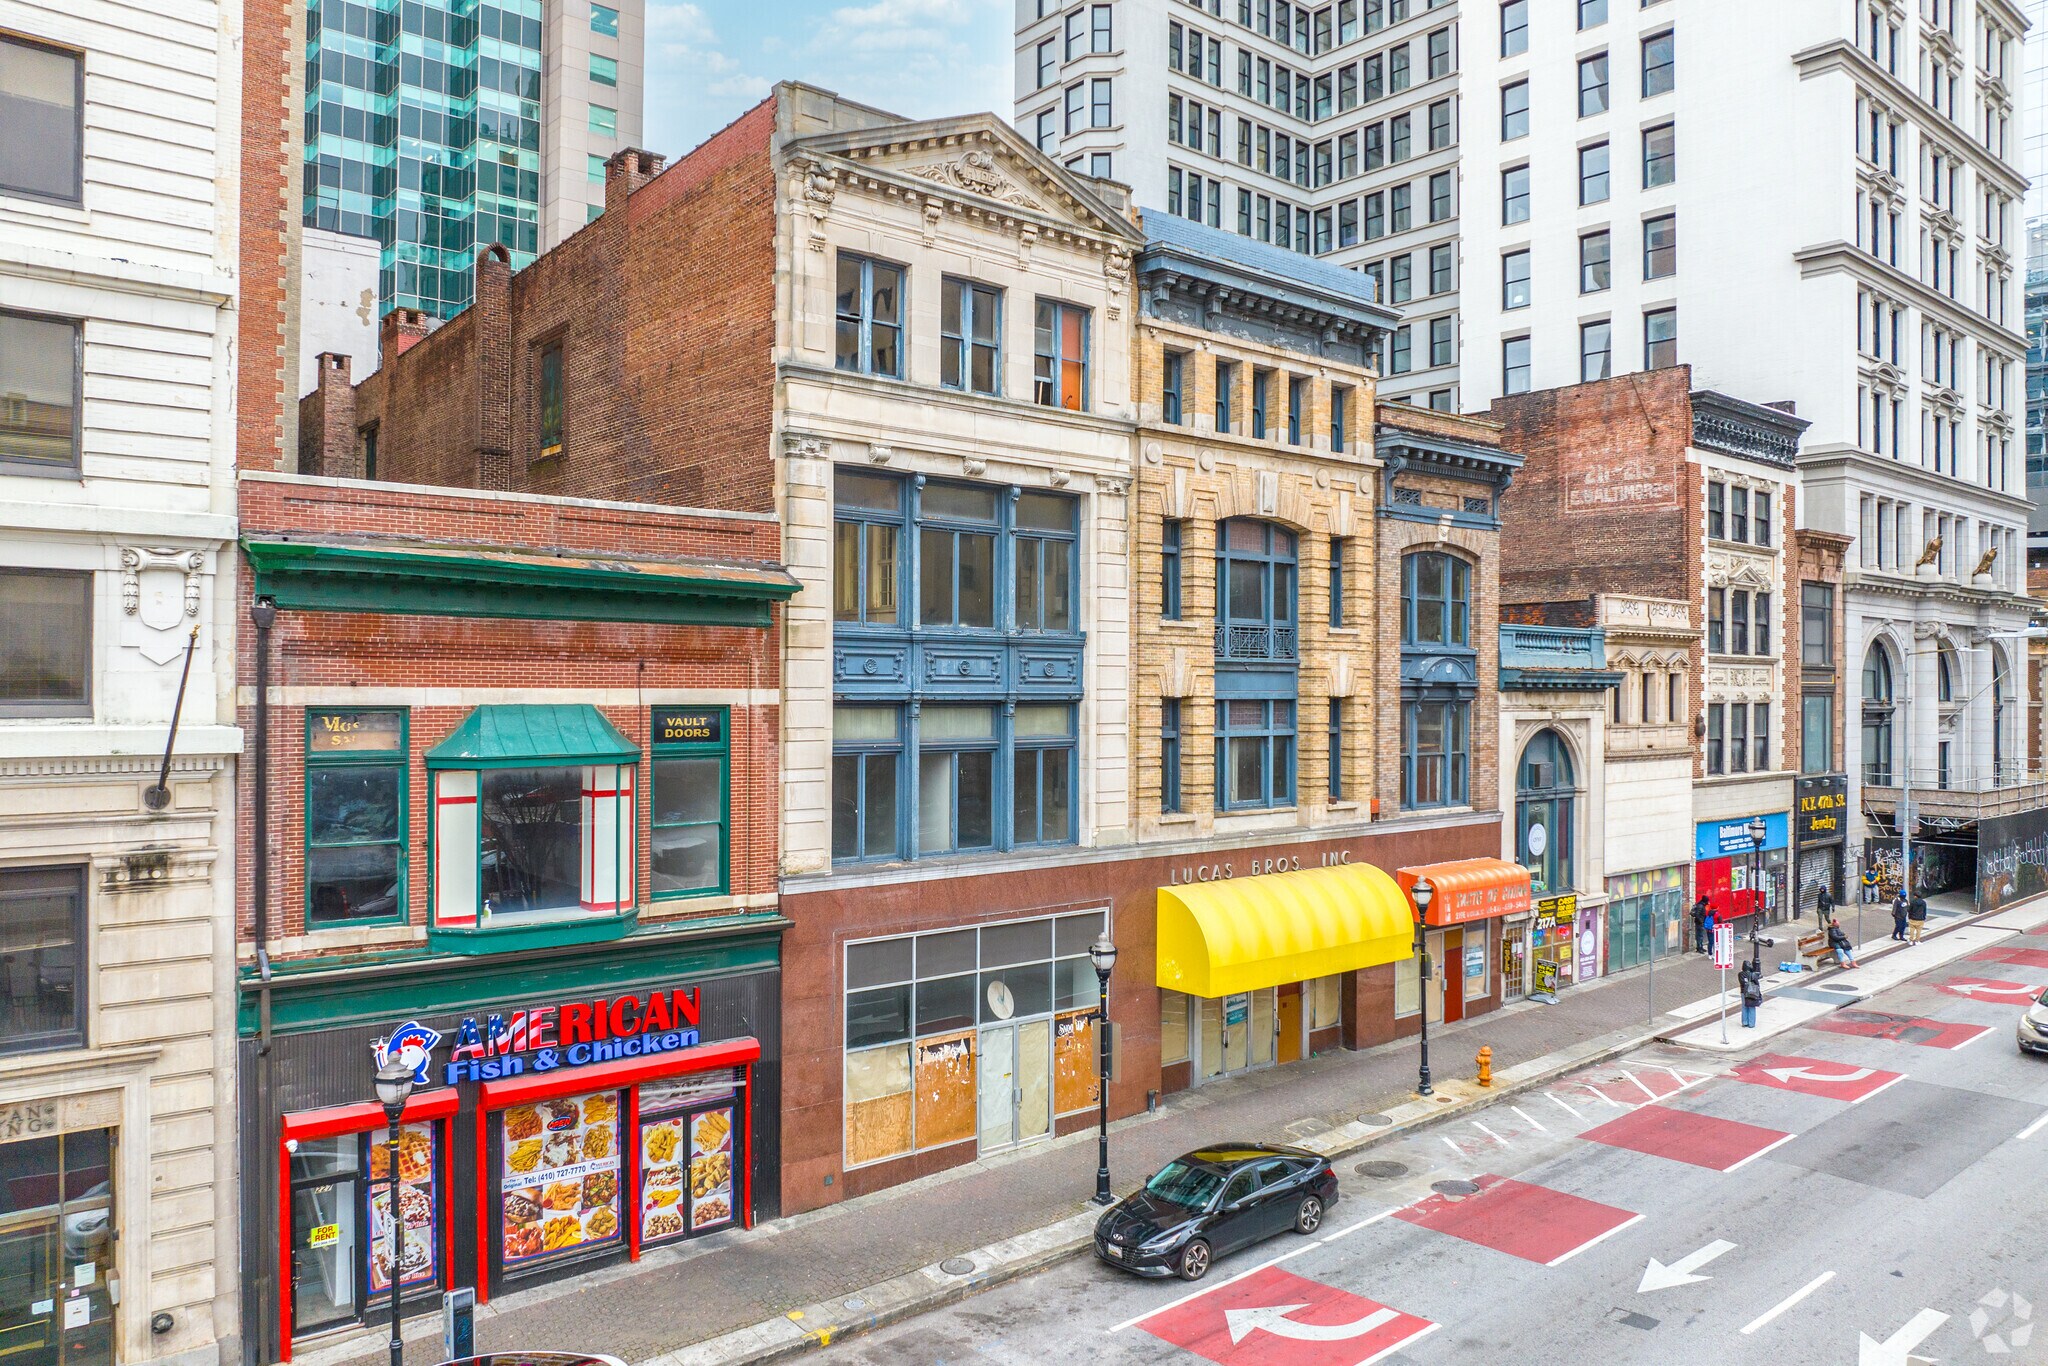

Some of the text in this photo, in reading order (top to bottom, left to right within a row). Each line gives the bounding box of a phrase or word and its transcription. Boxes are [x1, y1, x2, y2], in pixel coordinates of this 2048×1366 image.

[666, 717, 707, 727] VAULT
[664, 728, 711, 738] DOORS
[1810, 815, 1837, 830] Jewelry
[1719, 824, 1744, 839] Baltimore
[1170, 863, 1233, 886] LUCAS
[1321, 850, 1351, 867] INC
[1487, 887, 1499, 903] OF
[1537, 916, 1556, 930] 217A
[451, 986, 700, 1062] AMERICAN
[446, 1028, 701, 1085] Fish & Chicken
[547, 1116, 572, 1129] OPEN
[524, 1176, 537, 1185] Tel:
[538, 1172, 555, 1184] (410)
[556, 1165, 587, 1177] 727-7770
[314, 1232, 335, 1242] RENT
[317, 1225, 333, 1235] FOR
